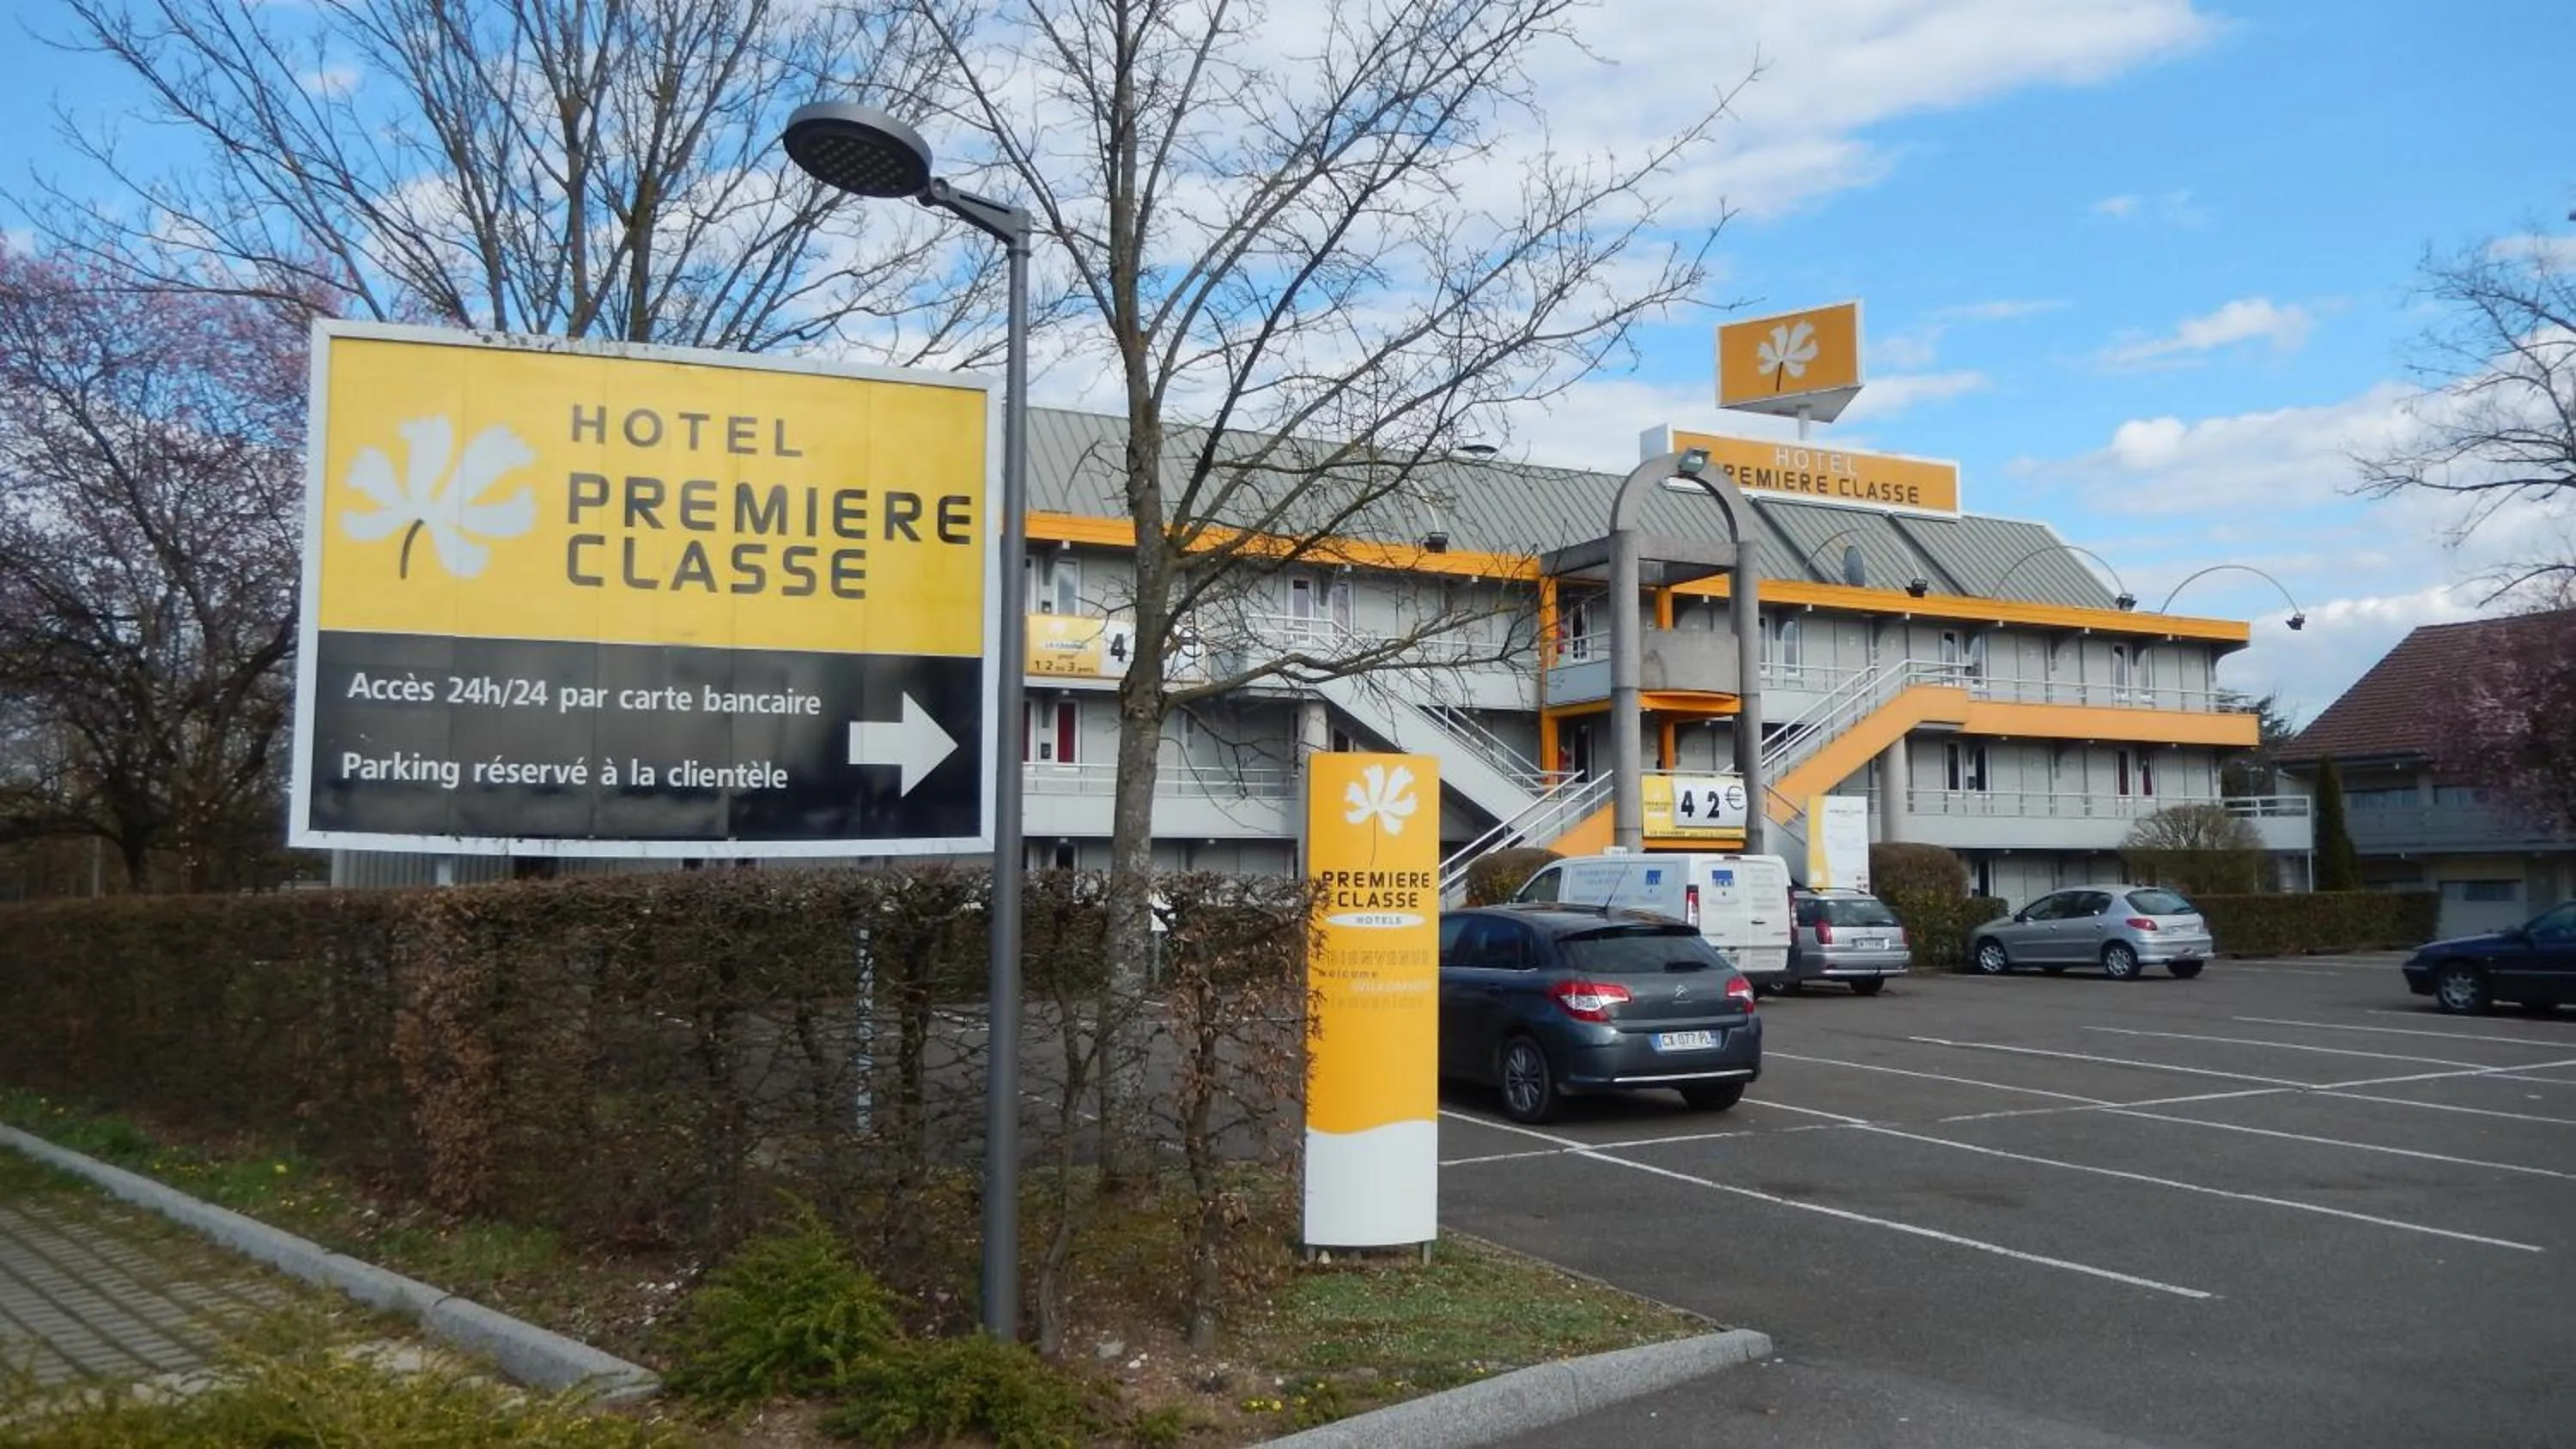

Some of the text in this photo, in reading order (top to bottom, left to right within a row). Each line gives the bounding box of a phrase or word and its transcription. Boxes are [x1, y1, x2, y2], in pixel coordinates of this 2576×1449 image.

[571, 403, 803, 458] HOTEL
[1776, 446, 1857, 476] HOTEL
[1722, 464, 1920, 504] REMIERE CLASSE
[568, 471, 973, 546] PREMIERE
[566, 532, 868, 600] CLASSE
[1110, 633, 1126, 662] 4
[1067, 661, 1076, 671] 3
[348, 672, 822, 716] Accès 24h/24 par carte bancaire
[343, 753, 788, 789] Parking réservé à la clientèle
[1322, 871, 1430, 888] PREMIERE
[1338, 892, 1418, 907] CLASSE
[1356, 916, 1402, 925] HOTELS
